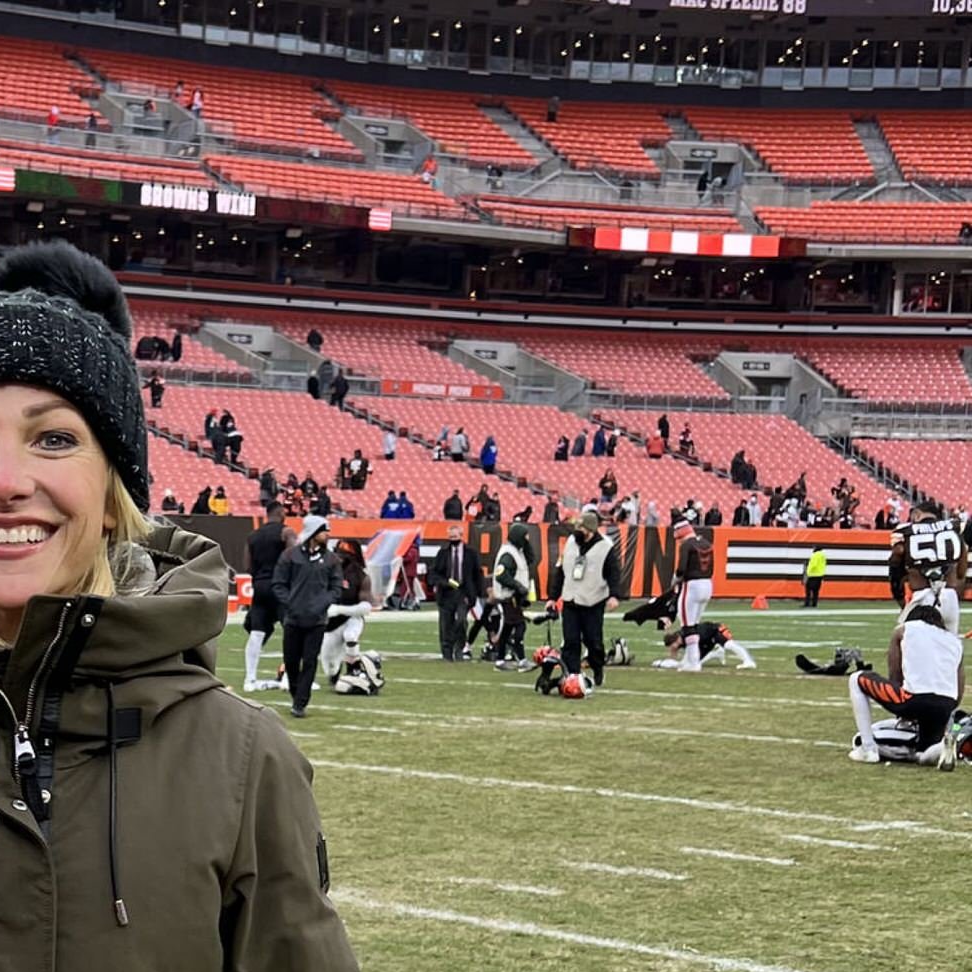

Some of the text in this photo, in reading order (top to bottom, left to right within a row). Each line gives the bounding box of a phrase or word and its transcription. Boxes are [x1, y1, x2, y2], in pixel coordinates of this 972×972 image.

[140, 183, 256, 216] BROWNS WIN!
[909, 530, 962, 562] 50
